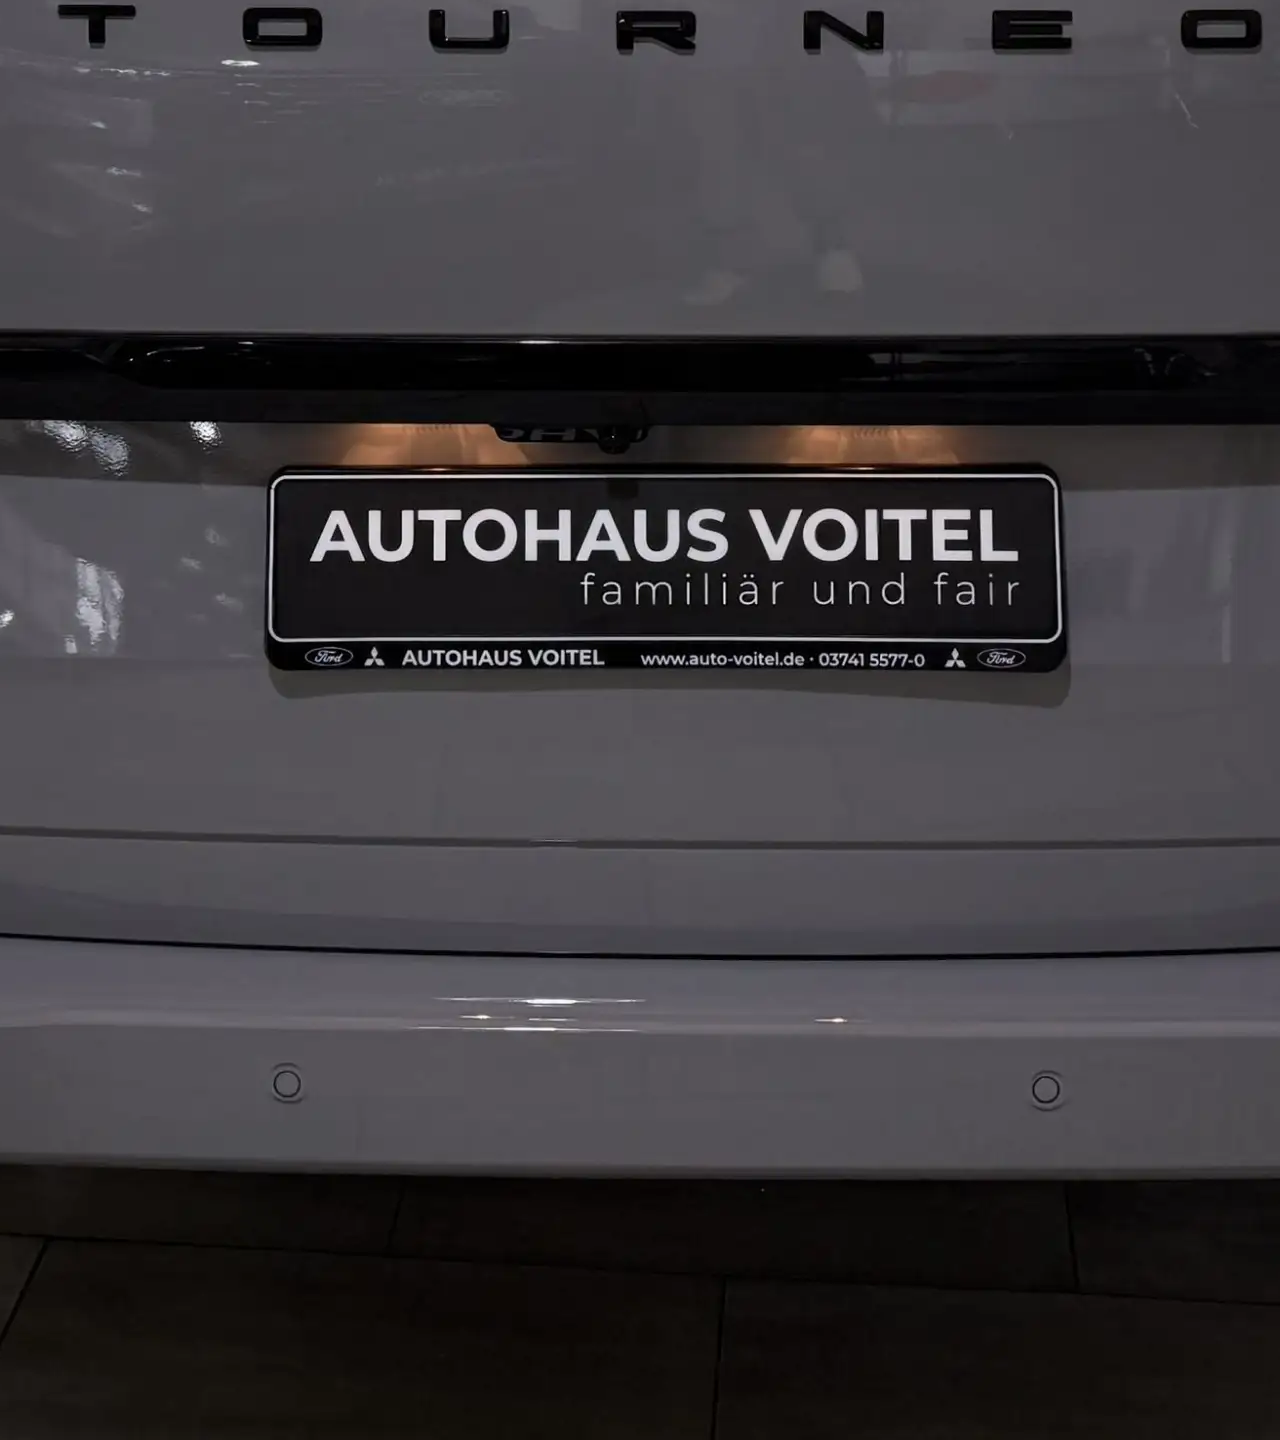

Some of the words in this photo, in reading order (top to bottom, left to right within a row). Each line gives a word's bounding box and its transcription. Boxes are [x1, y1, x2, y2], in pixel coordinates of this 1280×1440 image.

[58, 3, 1264, 53] TOURNEO
[310, 508, 729, 563] AUTOHAUS
[748, 508, 1019, 563] VOITEL
[580, 572, 784, 607] familiär
[812, 572, 907, 607] und
[933, 572, 1021, 607] fair
[314, 649, 343, 664] Ford
[401, 649, 522, 666] AUTOHAUS
[527, 649, 605, 666] VOITEL
[640, 651, 805, 667] www.auto-voitel.de
[819, 653, 865, 667] 03741
[869, 653, 926, 668] 5577-0
[987, 650, 1015, 665] Ford
